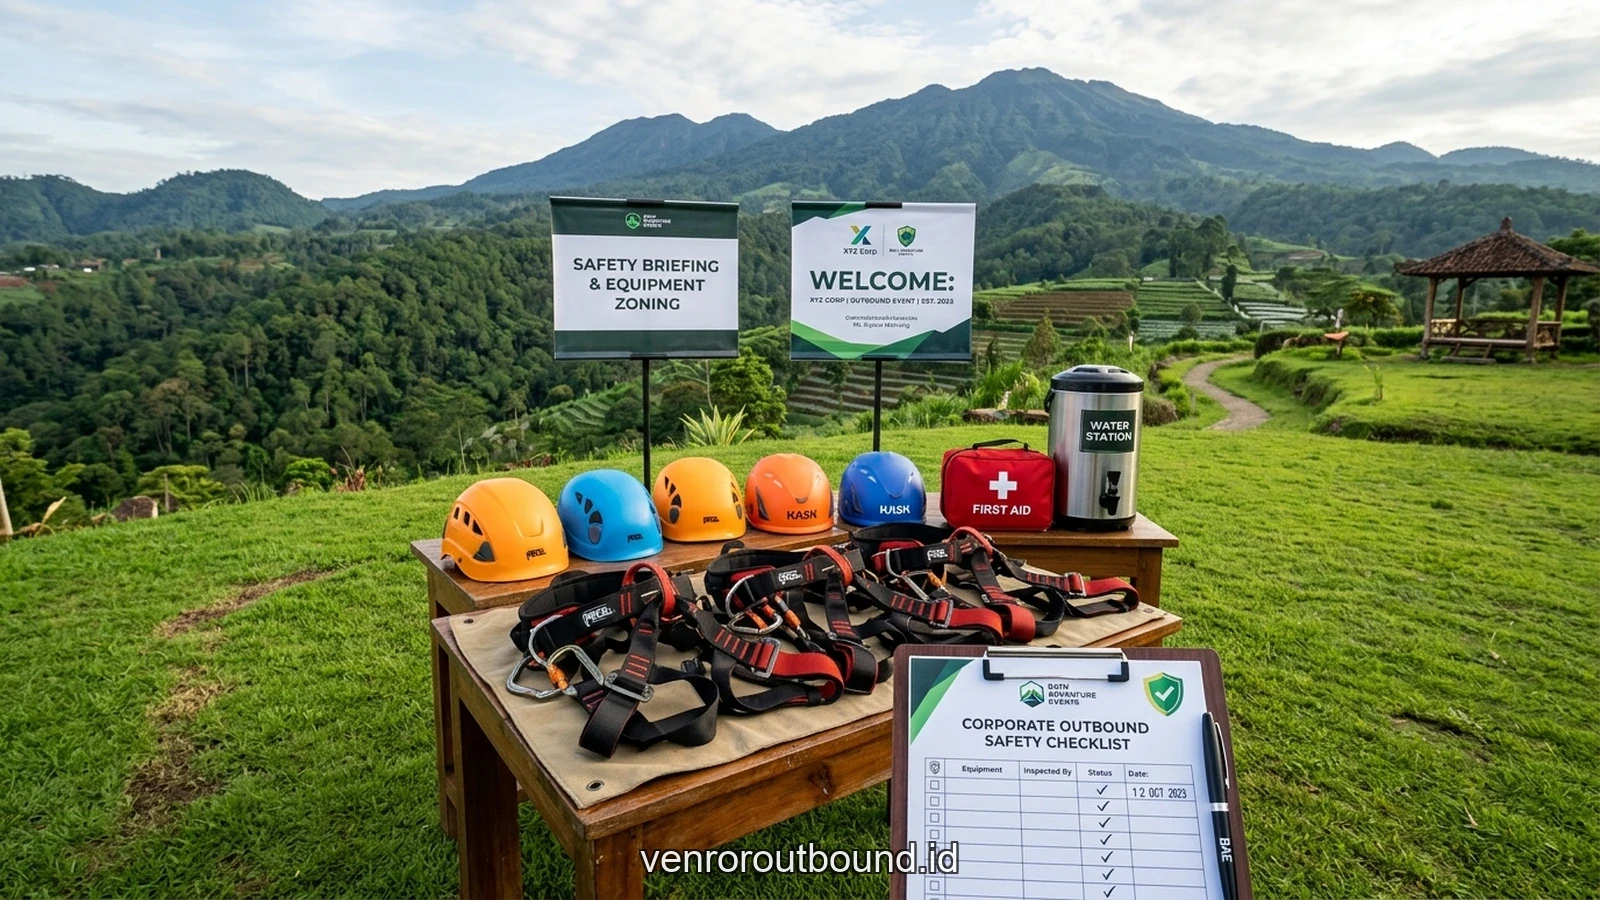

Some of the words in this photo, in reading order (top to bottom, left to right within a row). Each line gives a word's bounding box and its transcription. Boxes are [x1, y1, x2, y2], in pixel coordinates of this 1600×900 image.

[573, 258, 637, 271] SAFETY
[643, 259, 719, 272] BRIEFING
[589, 278, 600, 290] &
[606, 278, 705, 292] EQUIPMENT
[810, 270, 955, 291] WELCOME:
[615, 297, 680, 310] ZONING
[1090, 421, 1129, 431] WATER
[1085, 432, 1132, 442] STATION
[787, 510, 817, 520] KASK
[972, 504, 1007, 515] FIRST
[1010, 505, 1031, 516] AID
[962, 717, 1055, 732] CORPORATE
[1060, 720, 1149, 734] OUTBOUND
[984, 735, 1041, 748] SAFETY
[1046, 736, 1131, 751] CHECKLIST
[962, 765, 1003, 775] Equipment
[1023, 767, 1061, 777] Inspected
[1062, 768, 1072, 777] By
[1088, 769, 1113, 777] Status
[1128, 770, 1149, 778] Date:
[1219, 837, 1233, 862] BAE
